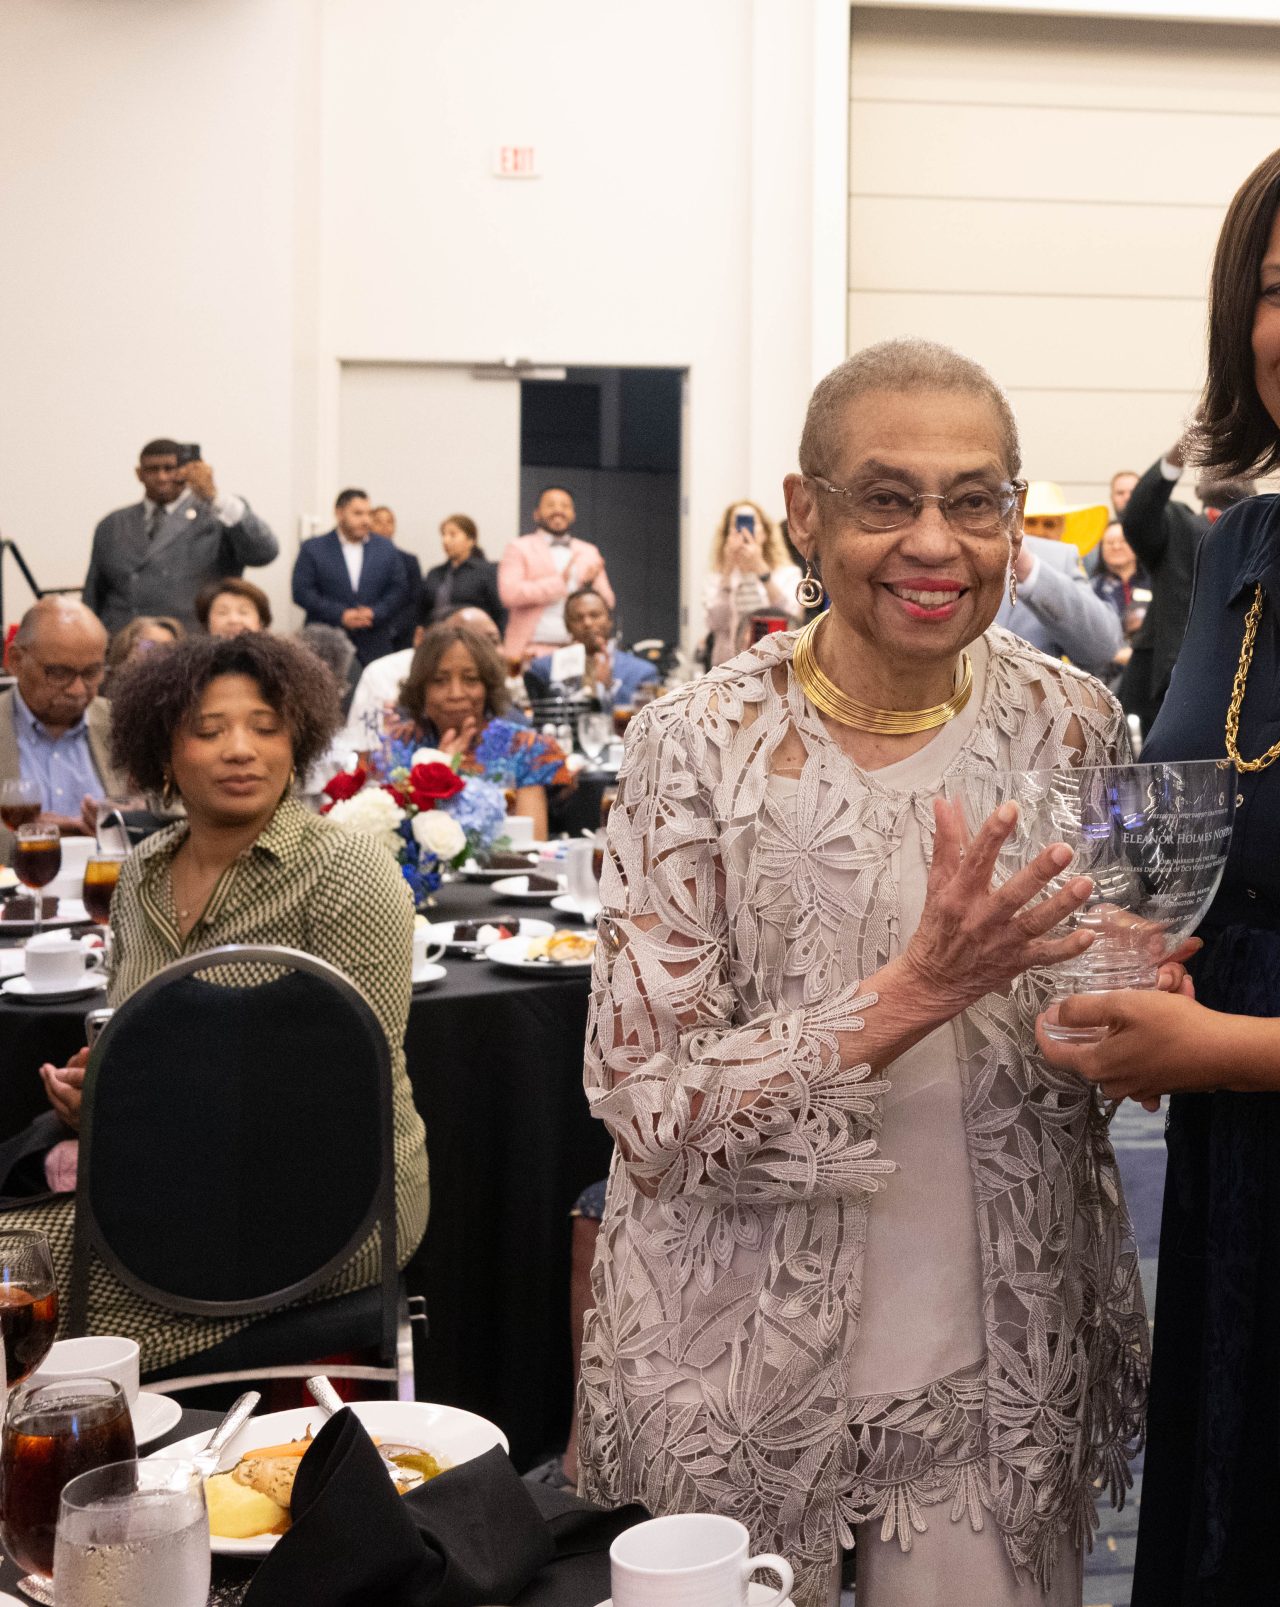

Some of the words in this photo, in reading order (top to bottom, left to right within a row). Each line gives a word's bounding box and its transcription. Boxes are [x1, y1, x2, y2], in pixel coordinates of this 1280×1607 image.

[500, 146, 534, 172] EXIT
[1123, 832, 1175, 845] ELEANOR
[1177, 831, 1213, 844] HOLMES
